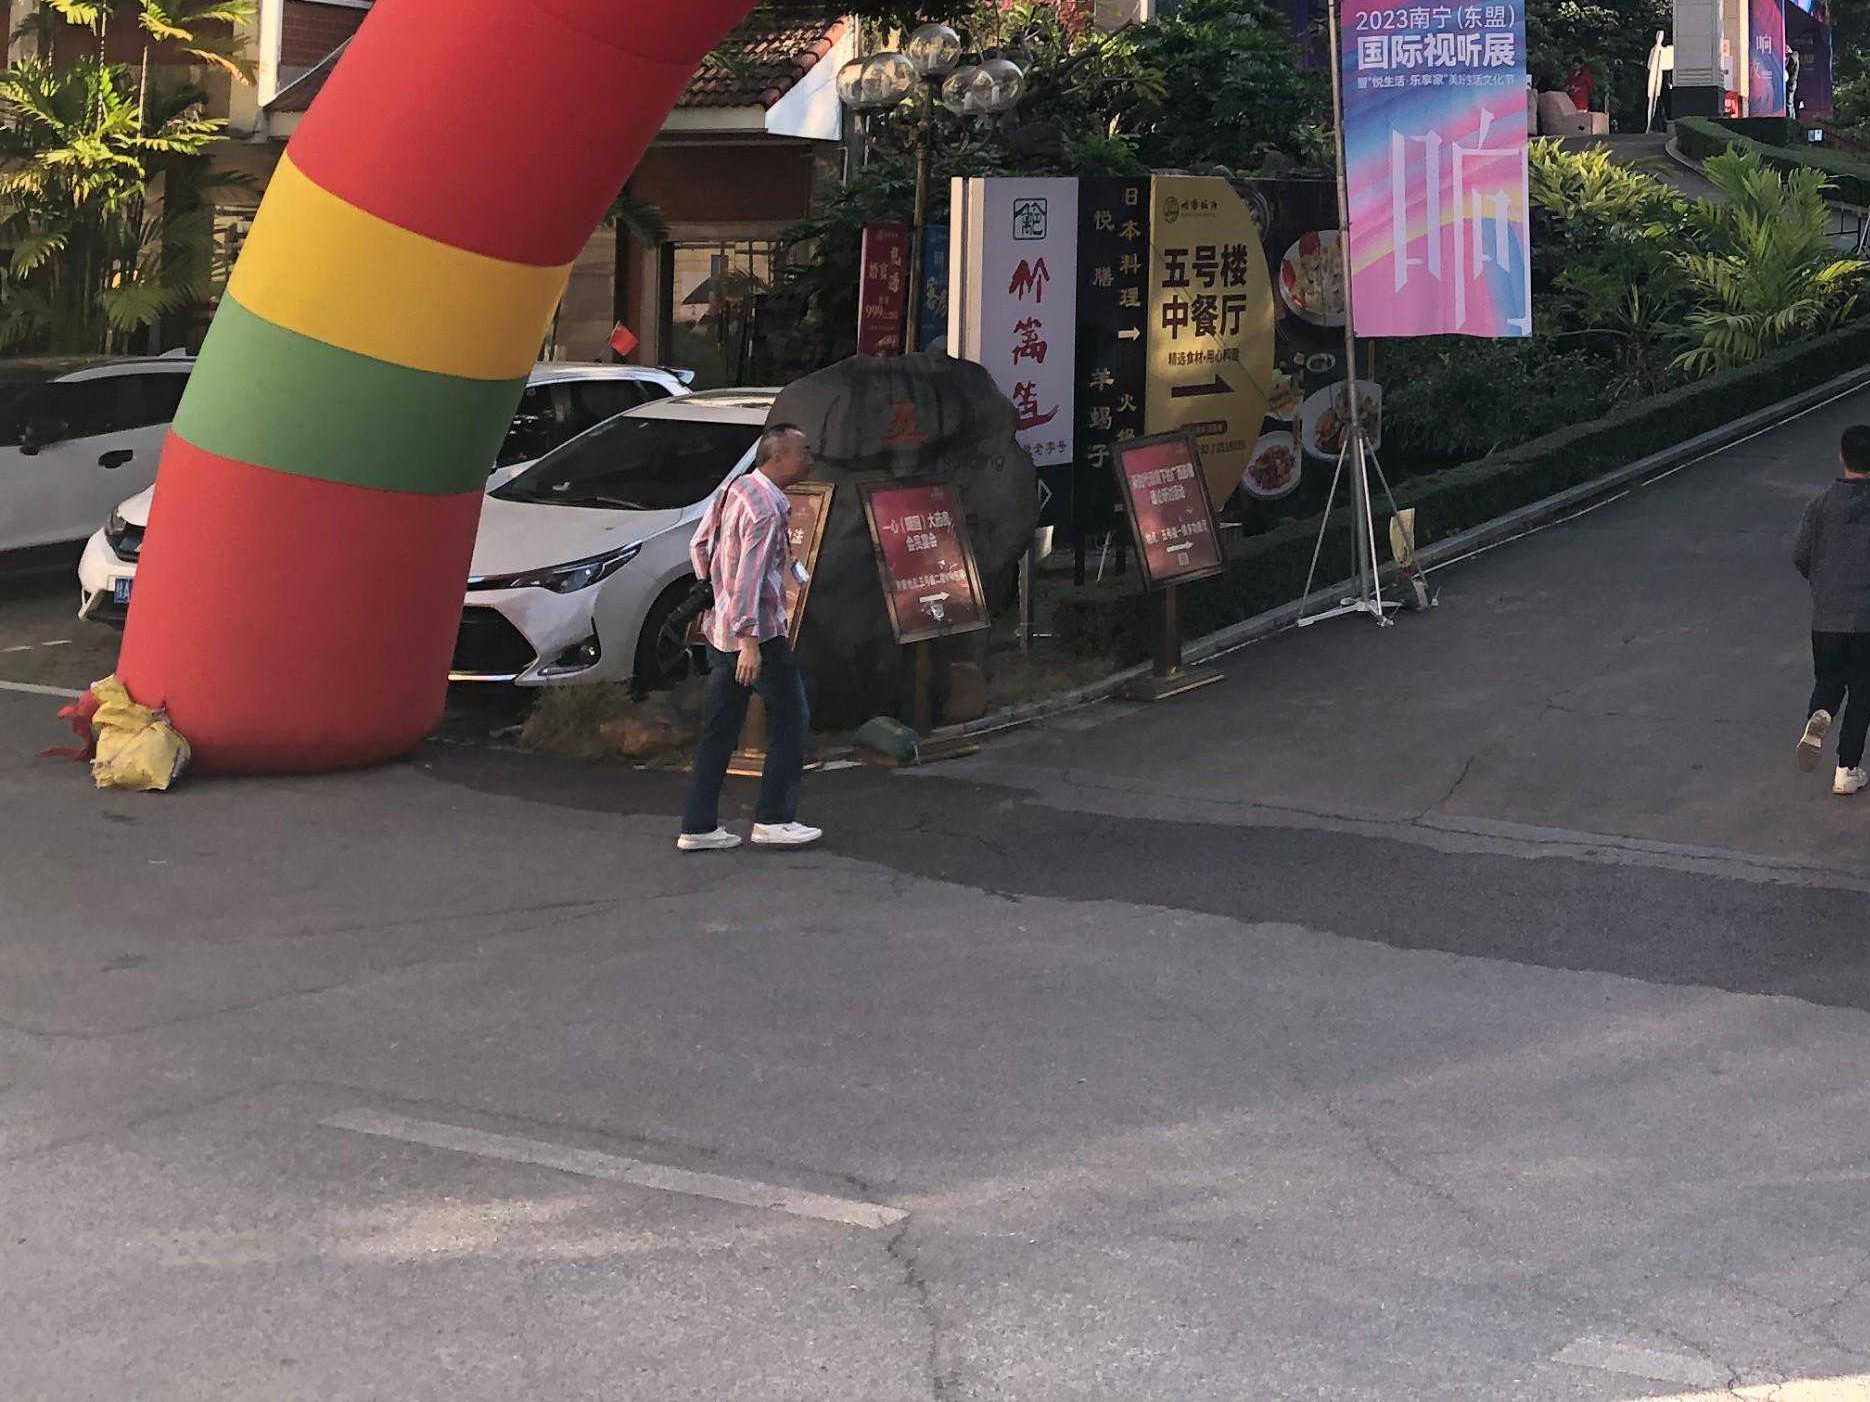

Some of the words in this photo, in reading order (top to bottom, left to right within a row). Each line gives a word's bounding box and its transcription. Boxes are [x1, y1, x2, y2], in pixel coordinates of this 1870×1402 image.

[1355, 4, 1516, 31] 2023南宁（东盟）
[1356, 32, 1516, 71] 国际视听展
[1118, 187, 1142, 308] 日本料理
[1161, 243, 1249, 289] 五号楼
[1161, 294, 1248, 340] 中餐厅
